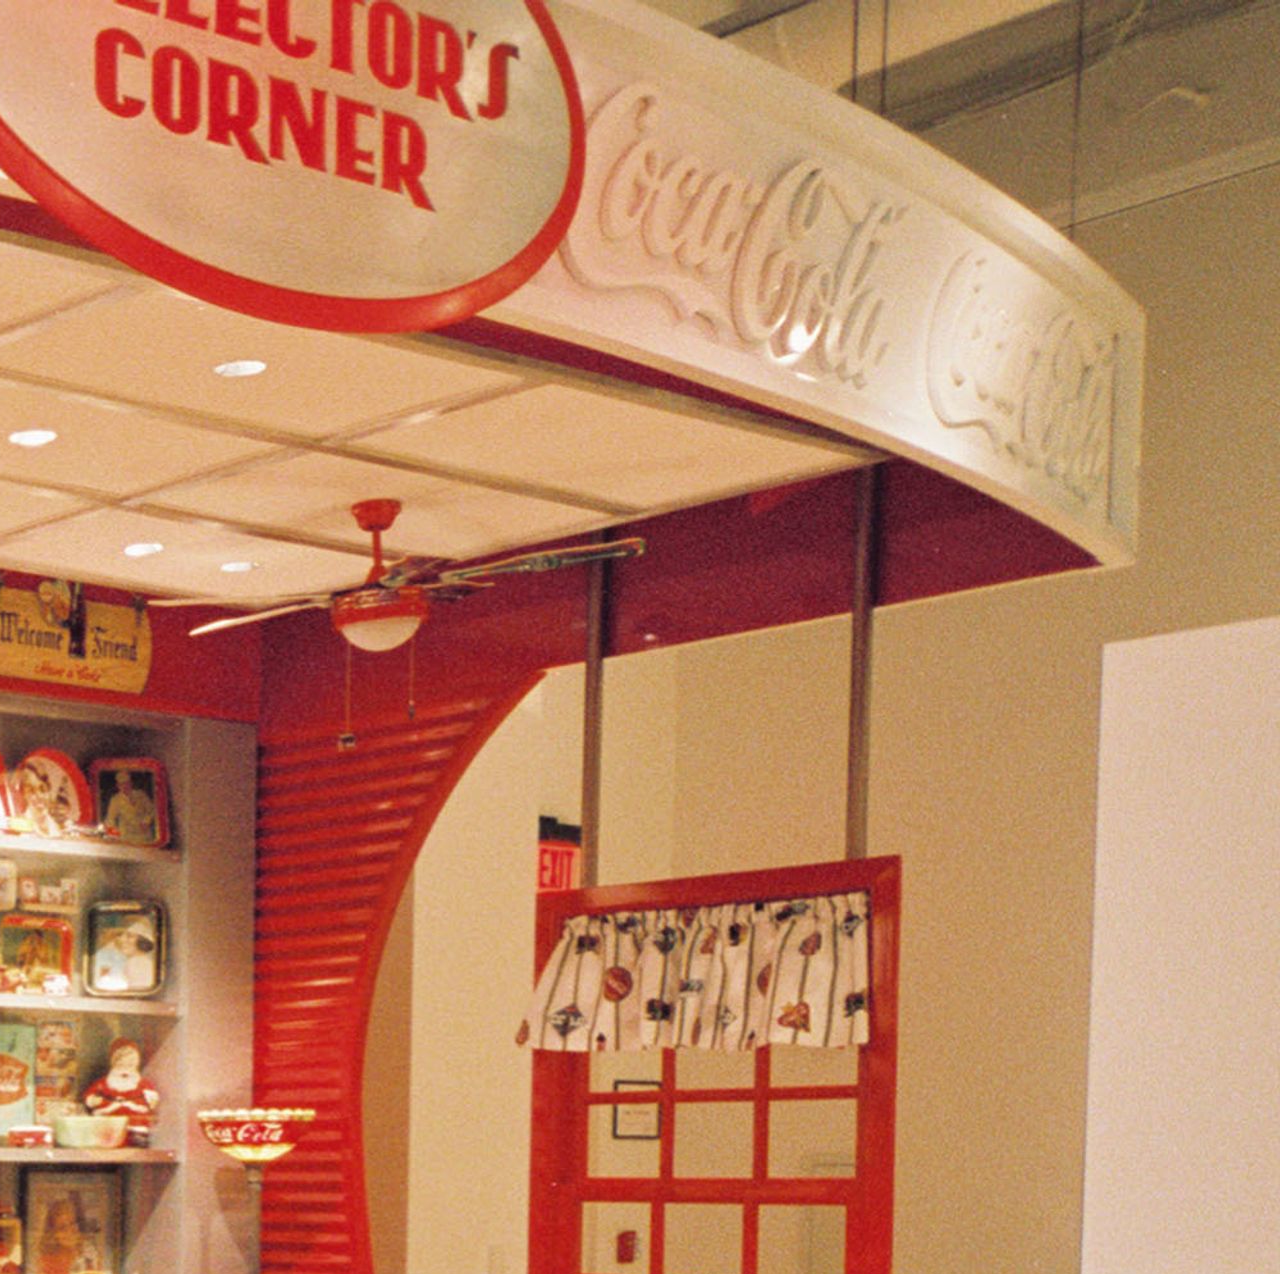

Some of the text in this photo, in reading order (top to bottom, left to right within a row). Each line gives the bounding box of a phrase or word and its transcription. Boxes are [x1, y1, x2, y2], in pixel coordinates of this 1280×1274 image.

[95, 28, 436, 212] CORNER
[0, 610, 138, 662] Welcome Friend
[539, 848, 574, 889] EXIT
[205, 1122, 284, 1143] Coca-Cola
